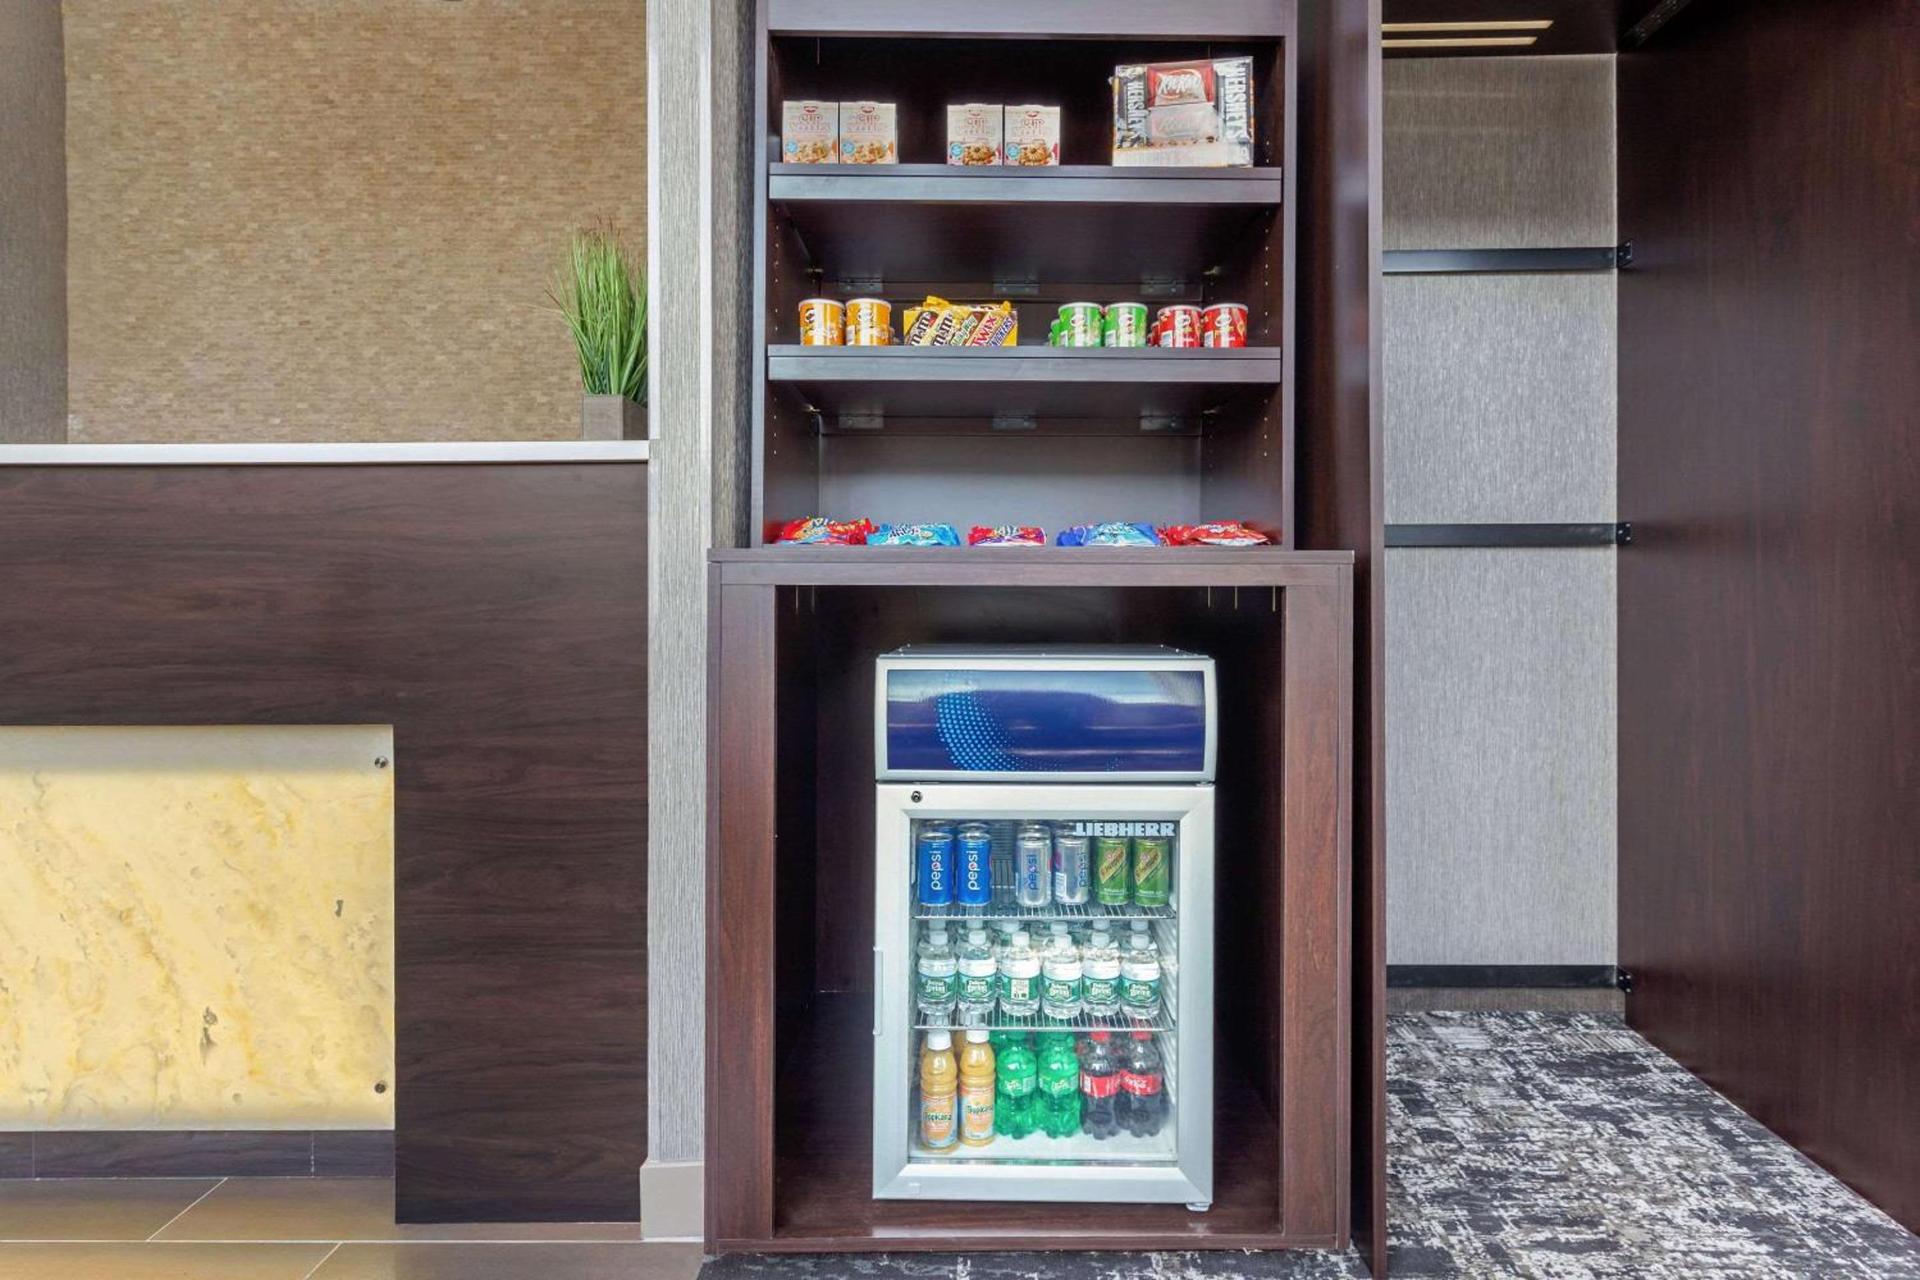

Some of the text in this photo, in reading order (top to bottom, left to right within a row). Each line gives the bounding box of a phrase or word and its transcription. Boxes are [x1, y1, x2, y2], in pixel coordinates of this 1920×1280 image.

[1072, 822, 1176, 837] LIEBHERR
[929, 850, 944, 891] pepsi
[966, 850, 981, 891] pepsi
[1026, 854, 1039, 890] pepsi
[1077, 852, 1088, 888] pepsi
